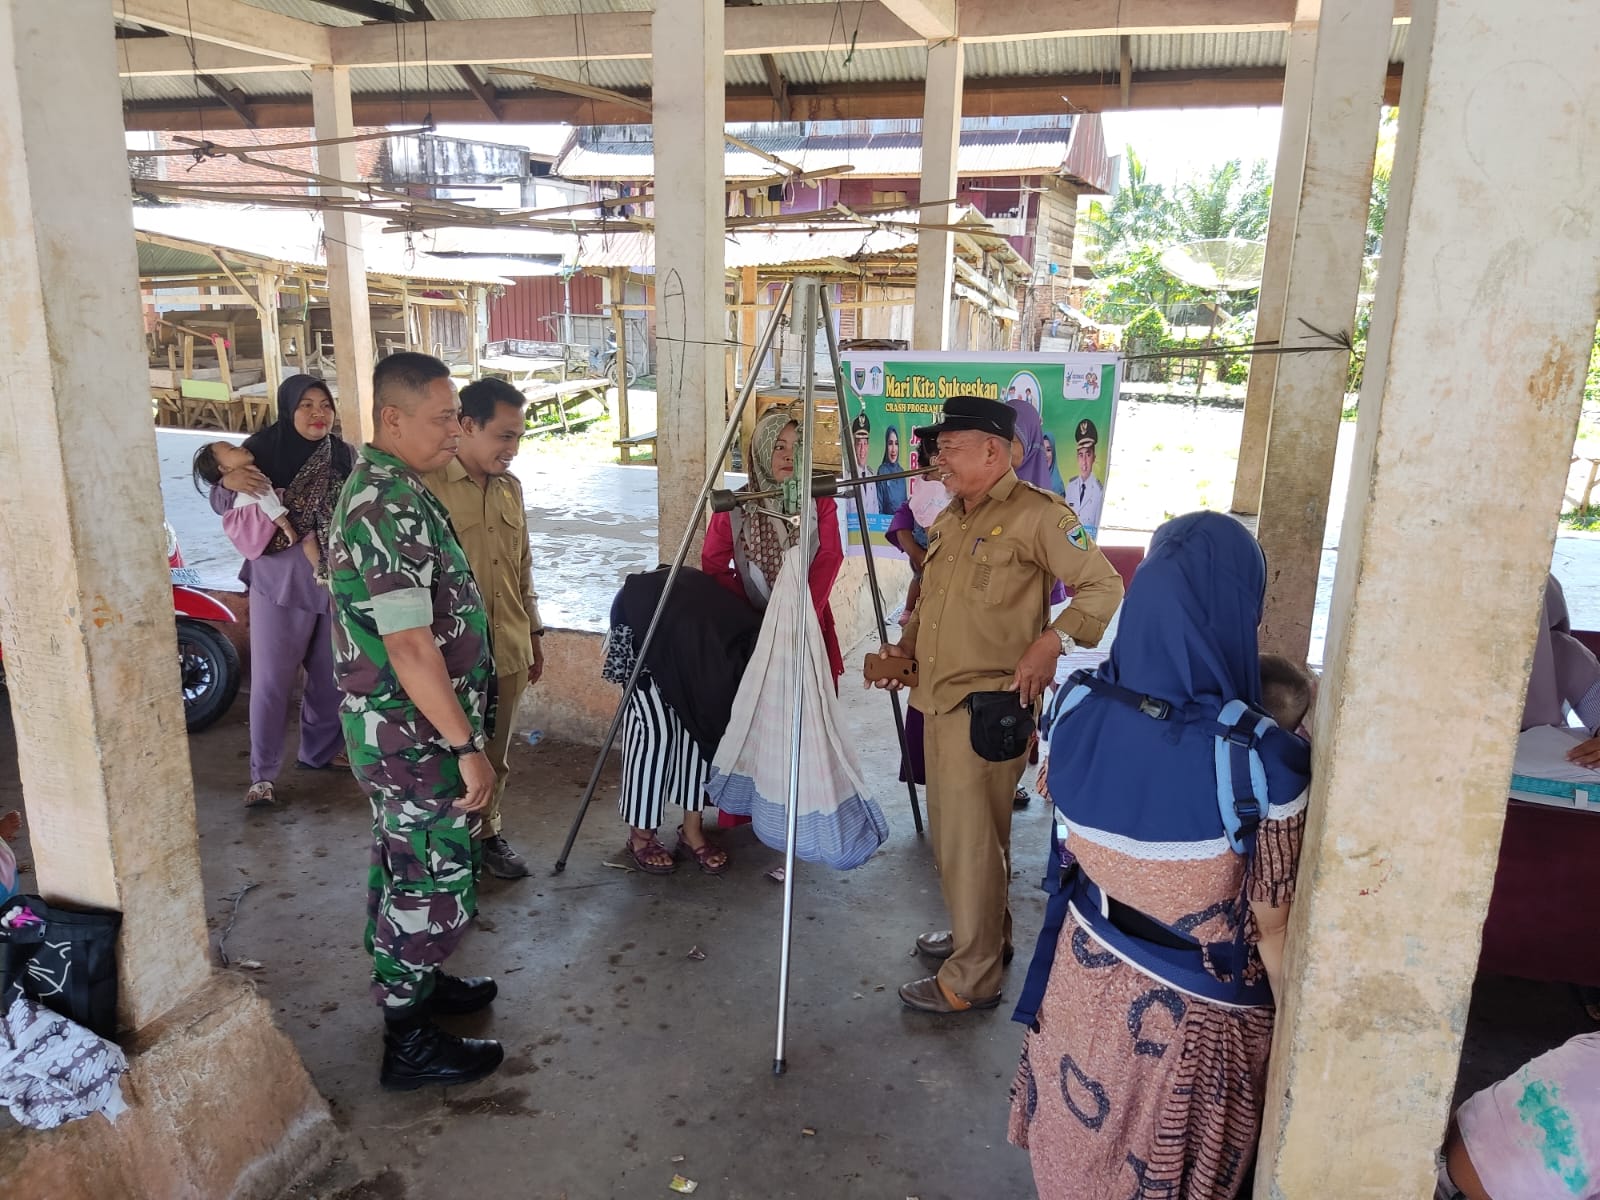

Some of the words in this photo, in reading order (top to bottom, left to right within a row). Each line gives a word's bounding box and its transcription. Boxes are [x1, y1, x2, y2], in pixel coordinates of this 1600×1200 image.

[885, 375, 910, 398] Mari
[912, 375, 936, 398] Kita
[938, 376, 998, 400] Sukseskan
[885, 403, 906, 412] CRASH
[907, 404, 938, 413] PROGRAM
